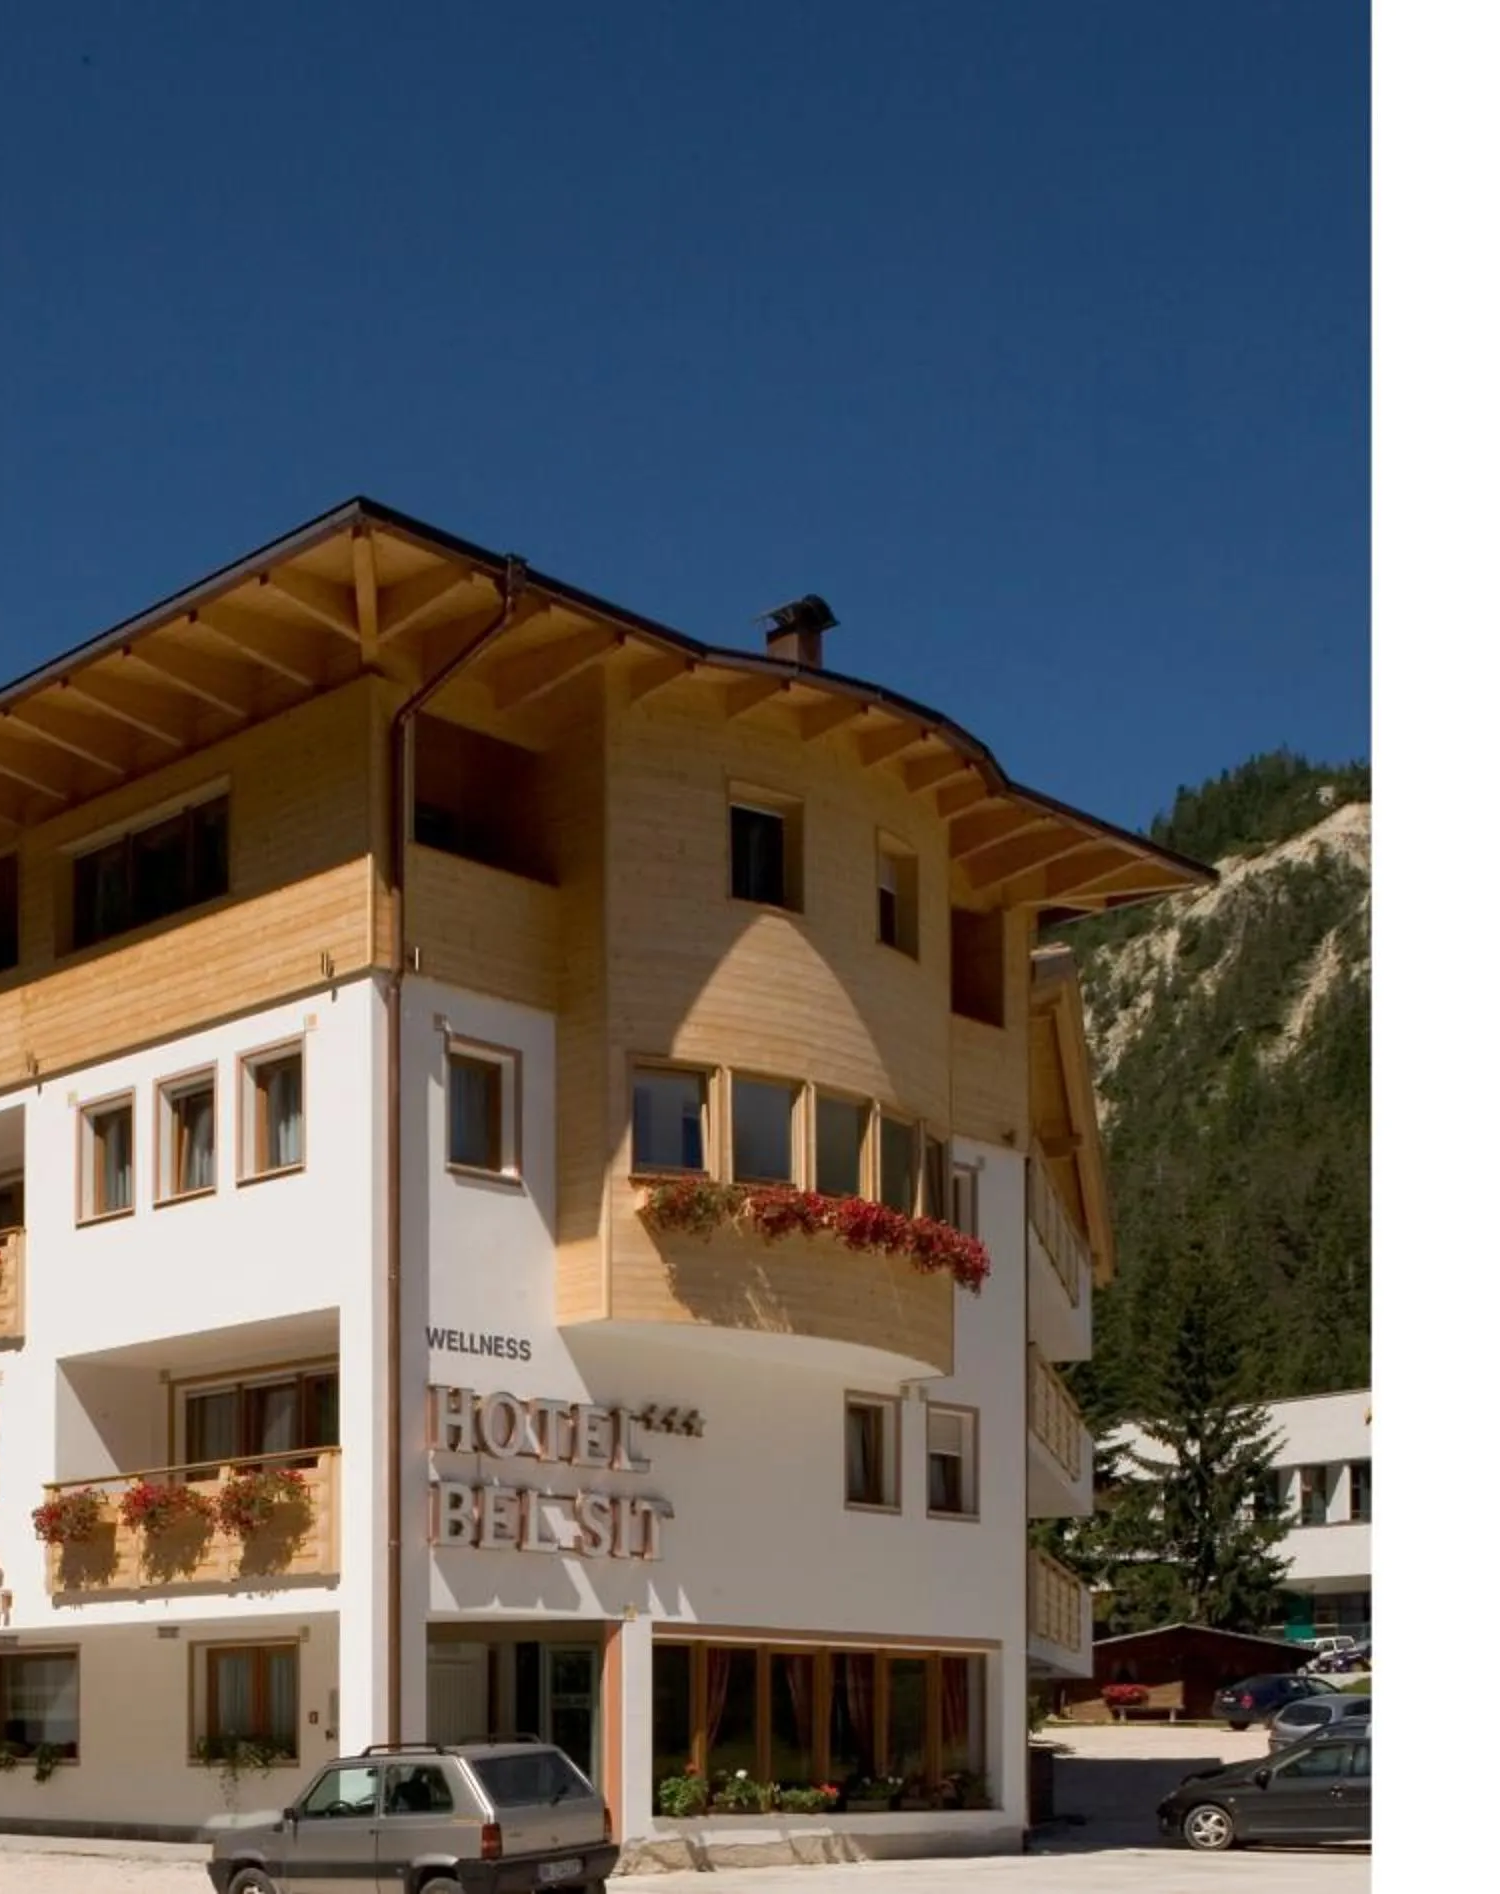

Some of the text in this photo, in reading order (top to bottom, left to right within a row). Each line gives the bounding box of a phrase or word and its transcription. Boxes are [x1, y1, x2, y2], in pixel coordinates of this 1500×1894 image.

[426, 1326, 532, 1361] WELLNESS
[425, 1385, 651, 1473] HOTEL
[426, 1480, 674, 1562] BEL SIT
